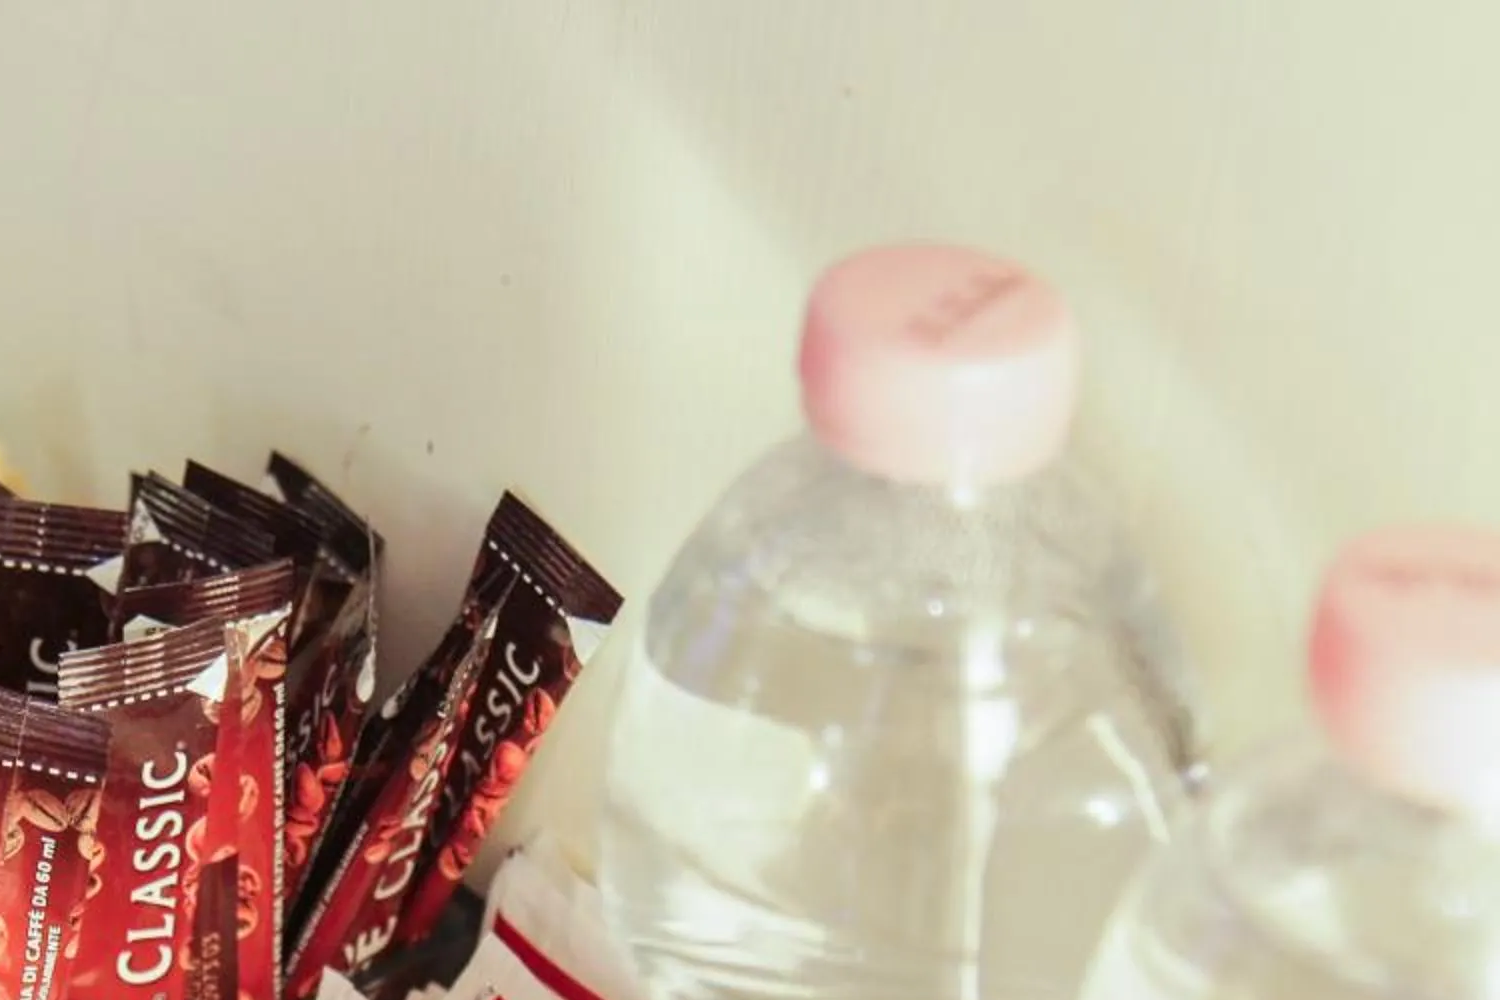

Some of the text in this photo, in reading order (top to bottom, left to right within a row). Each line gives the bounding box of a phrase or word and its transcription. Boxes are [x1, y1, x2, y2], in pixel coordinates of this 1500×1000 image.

[40, 835, 58, 859] ml
[35, 860, 53, 883] 60
[118, 751, 187, 986] CLASSIC
[32, 882, 50, 906] DA
[21, 963, 39, 982] DI
